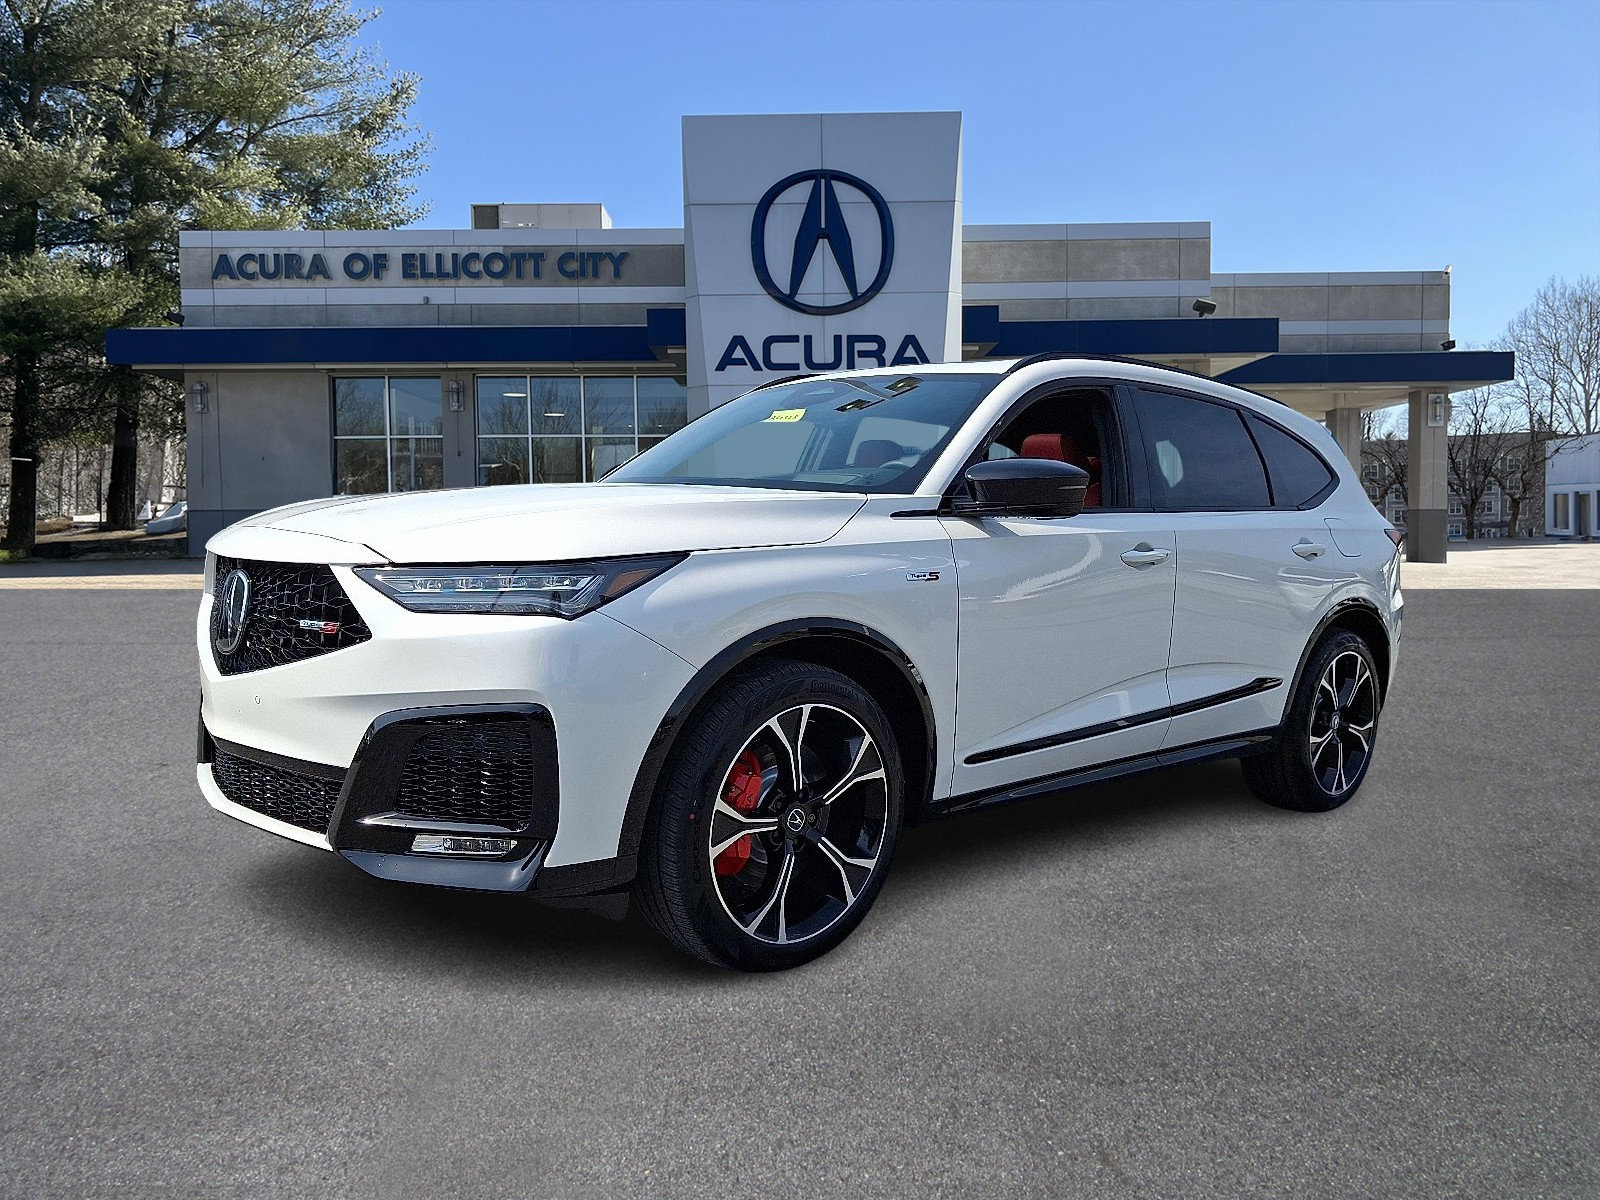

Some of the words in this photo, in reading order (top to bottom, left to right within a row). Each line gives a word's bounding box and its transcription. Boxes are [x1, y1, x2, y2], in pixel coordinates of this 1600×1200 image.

[211, 252, 332, 280] ACURA
[342, 252, 391, 280] OF
[401, 252, 546, 280] ELLICOTT
[557, 252, 629, 280] CITY
[714, 334, 931, 371] ACURA
